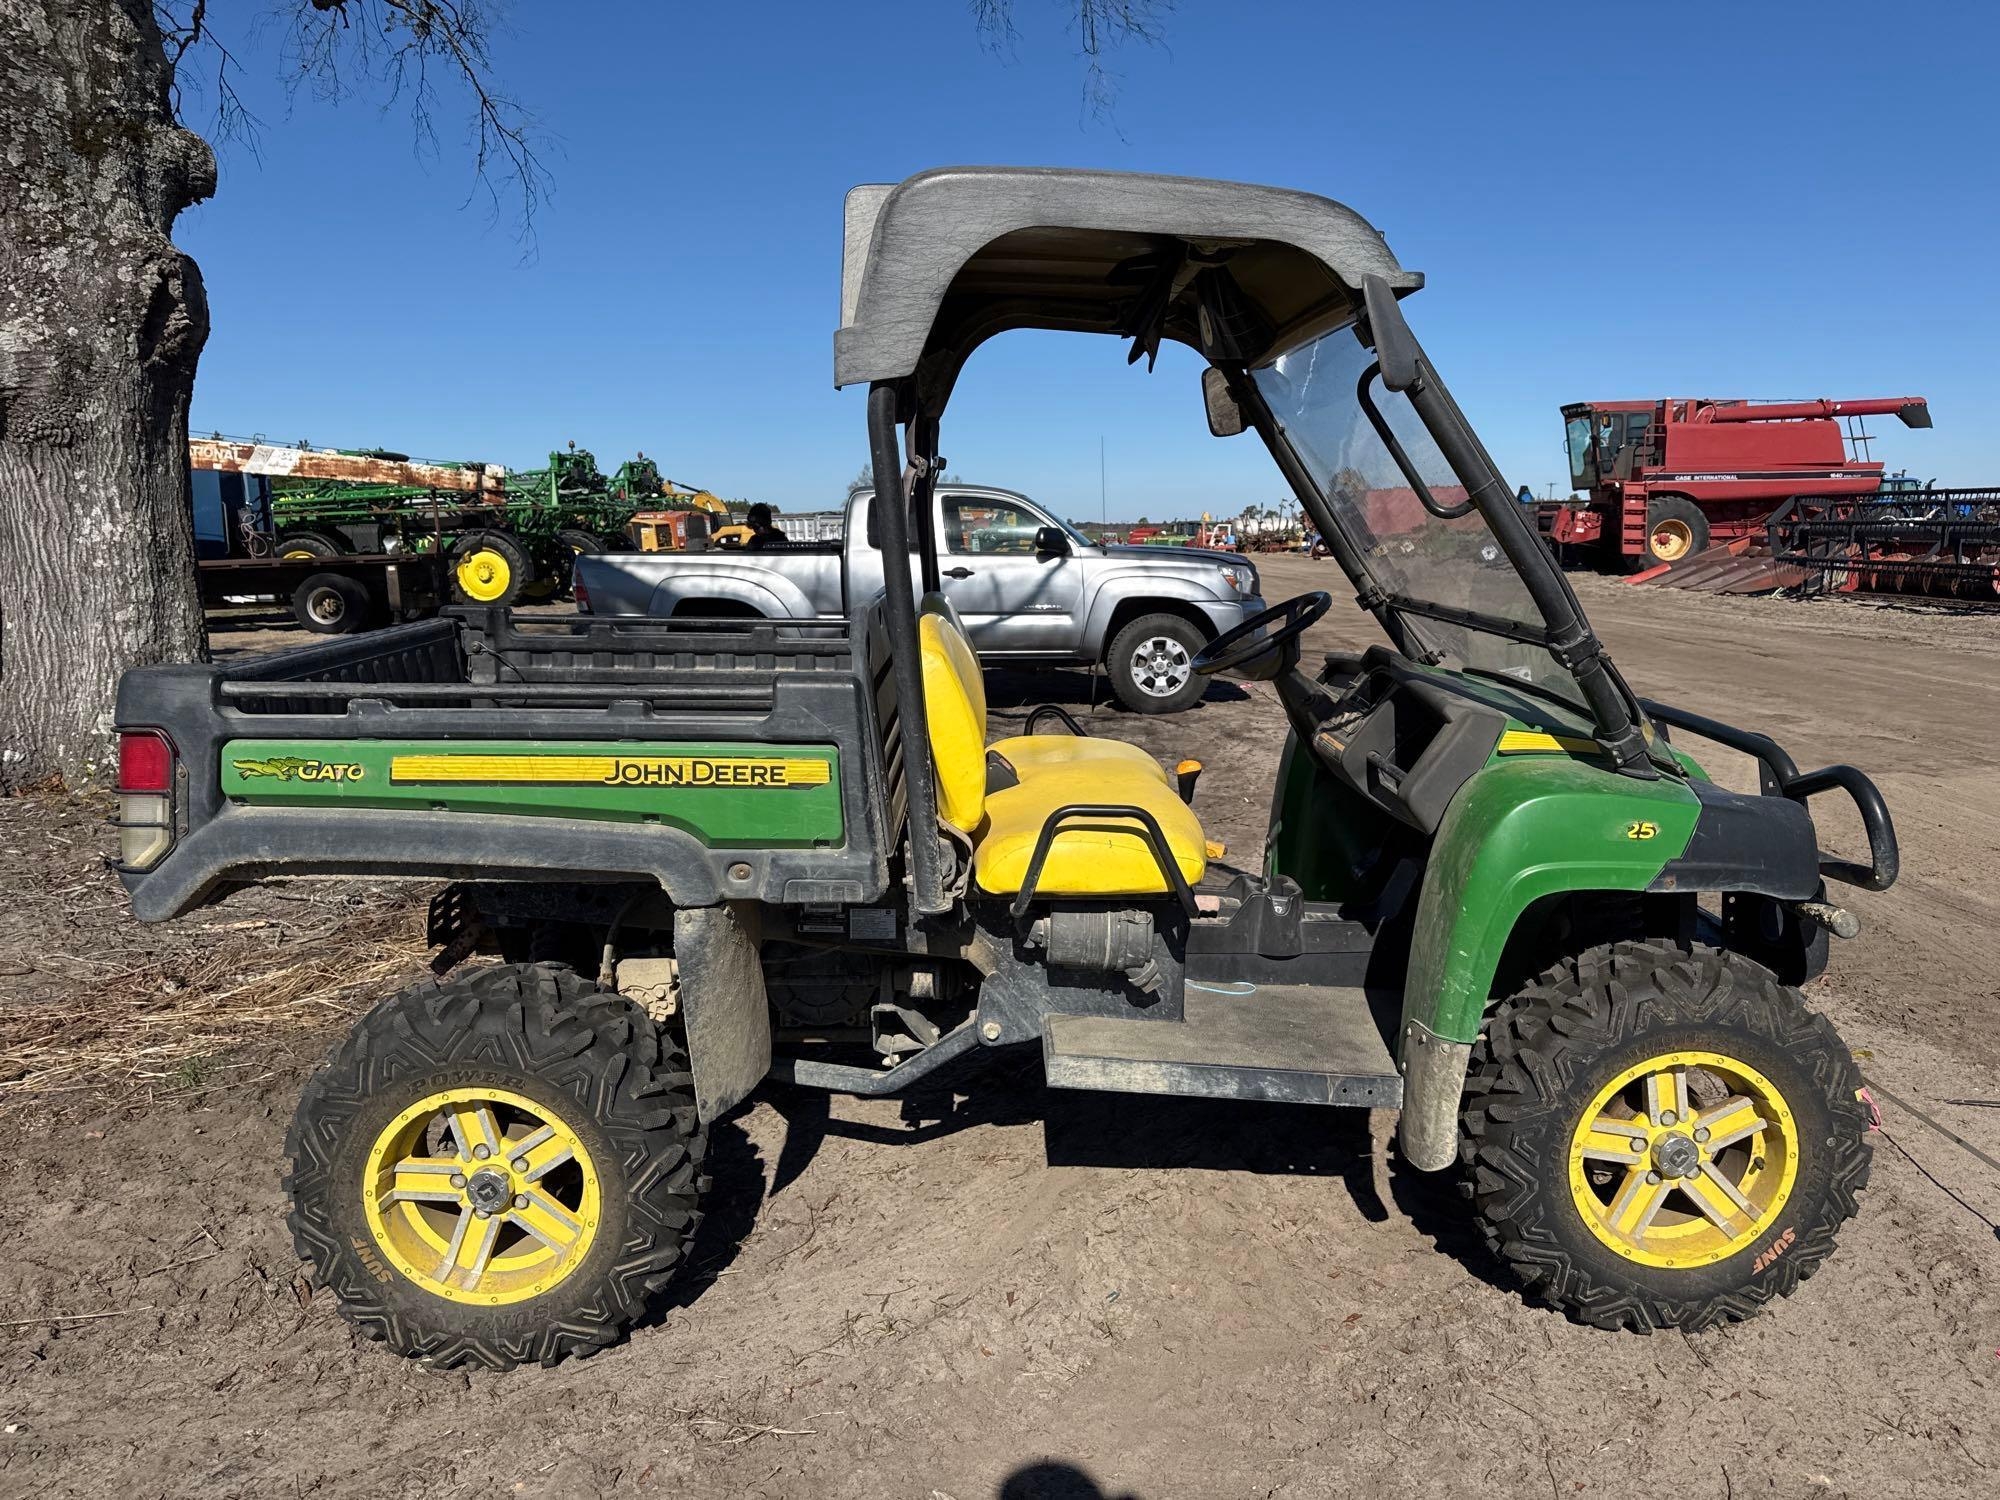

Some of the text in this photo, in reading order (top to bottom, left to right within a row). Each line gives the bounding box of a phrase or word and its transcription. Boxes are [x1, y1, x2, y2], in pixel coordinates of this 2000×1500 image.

[604, 759, 788, 784] JOHN DEERE
[407, 1070, 527, 1097] POWER
